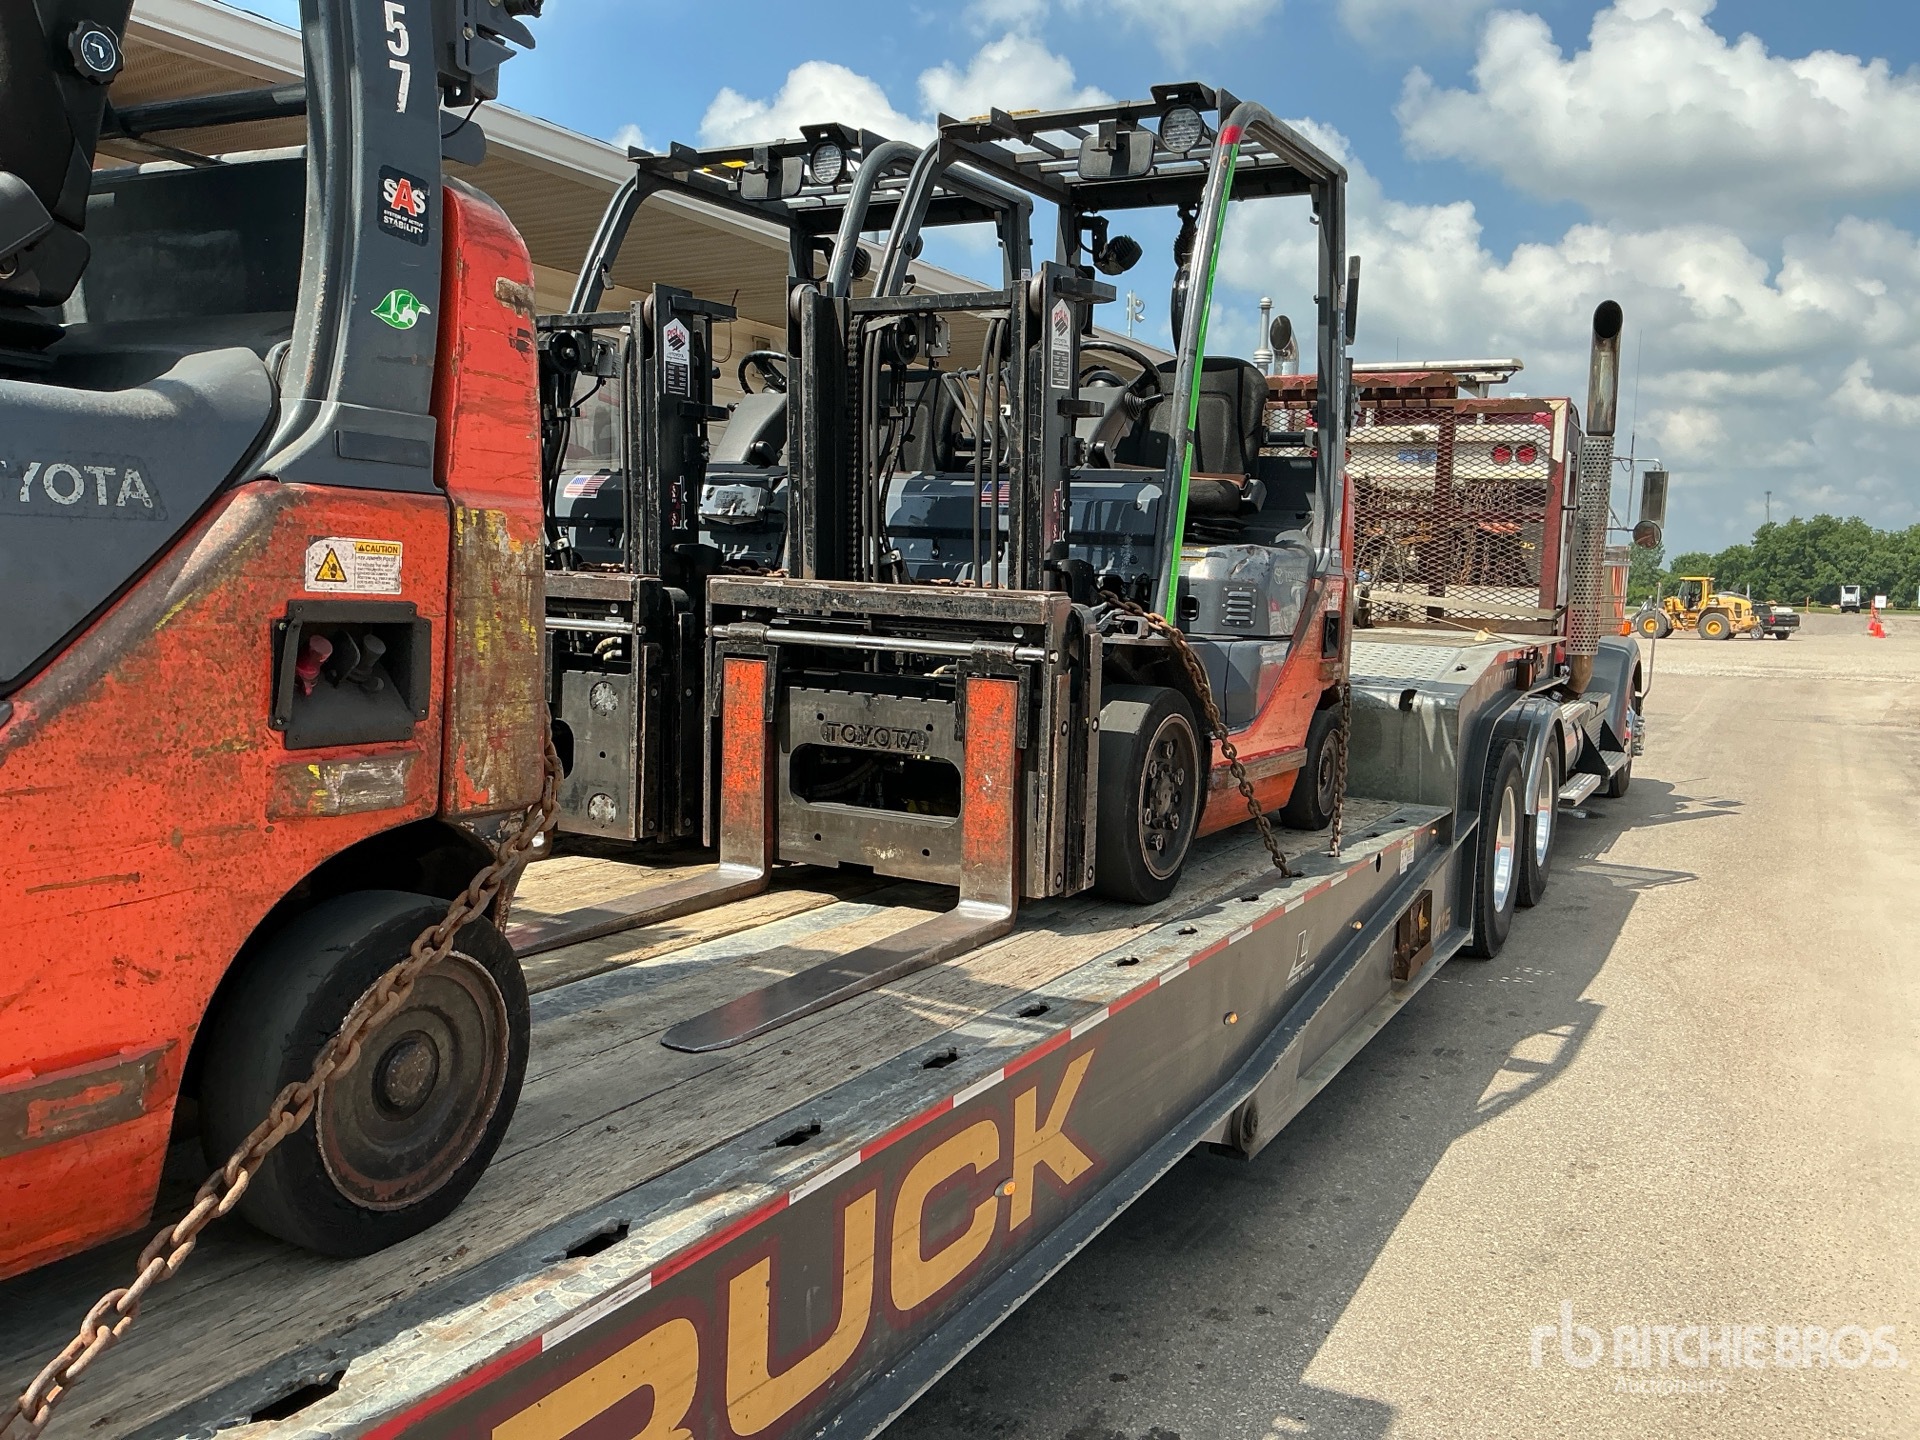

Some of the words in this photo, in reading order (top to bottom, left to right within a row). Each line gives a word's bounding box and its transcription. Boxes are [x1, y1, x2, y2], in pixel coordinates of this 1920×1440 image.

[383, 178, 426, 217] SAS
[383, 215, 424, 234] STABILITY
[365, 545, 398, 554] CAUTION
[827, 722, 924, 752] TOYOTA
